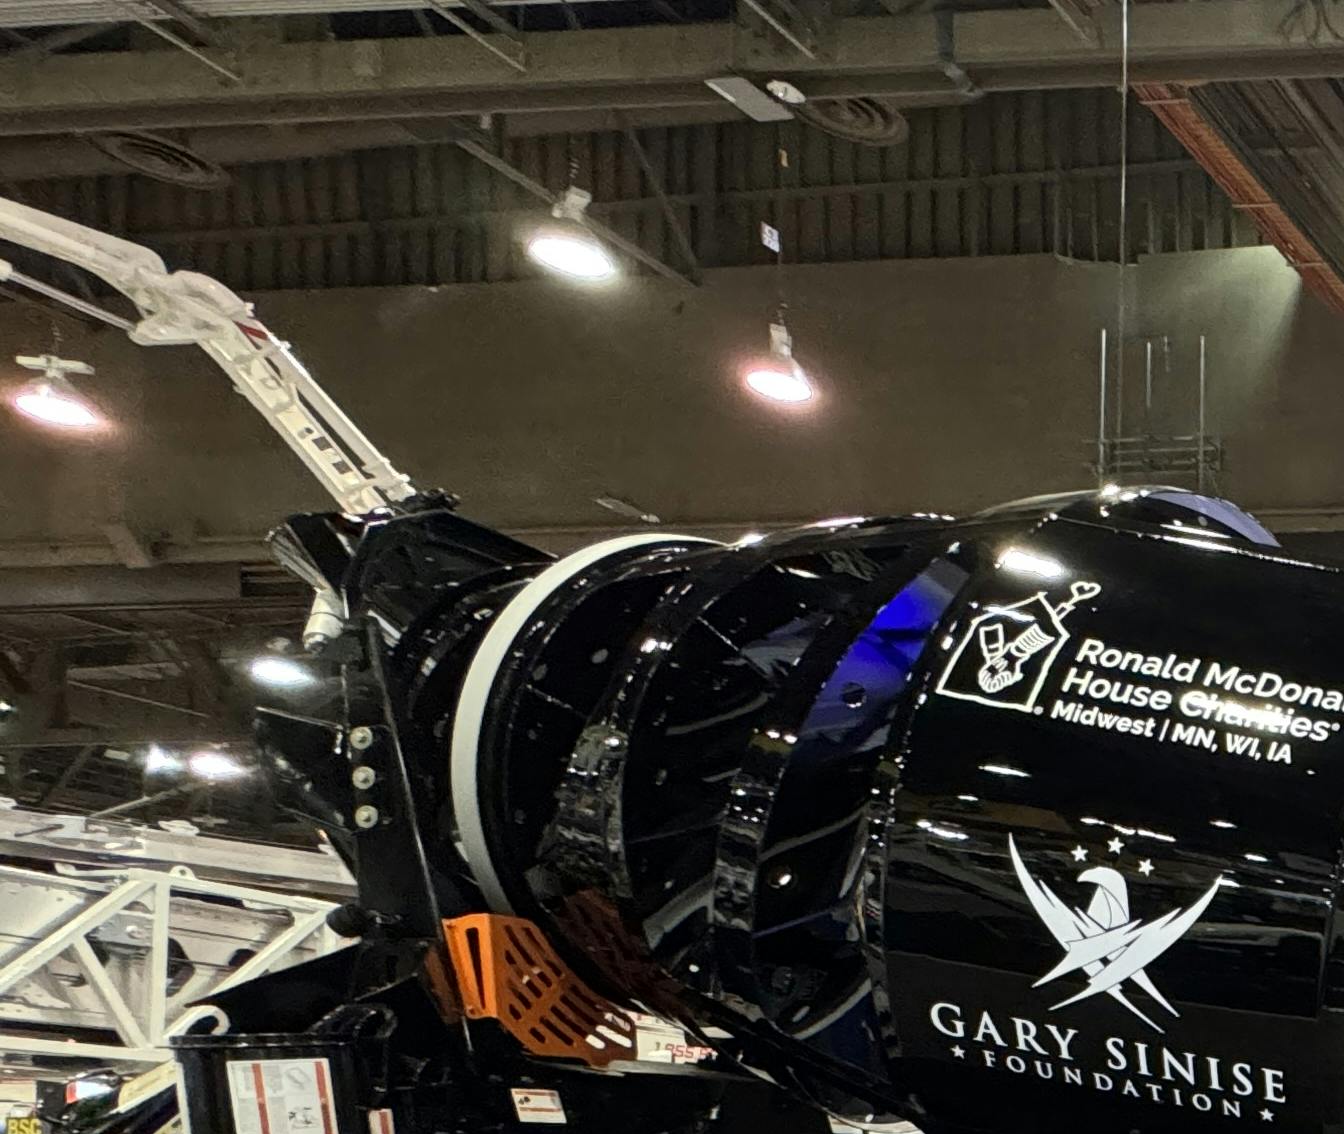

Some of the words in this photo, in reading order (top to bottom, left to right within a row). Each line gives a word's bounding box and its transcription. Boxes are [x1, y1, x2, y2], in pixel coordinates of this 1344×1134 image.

[1062, 668, 1172, 712] House
[1074, 639, 1201, 683] Ronald
[1051, 701, 1156, 738] Midwest
[1171, 723, 1218, 752] MN,
[1225, 732, 1262, 760] WI,
[1266, 742, 1293, 765] IA
[930, 1002, 1079, 1061] GARY
[1106, 1037, 1286, 1104] SINISE
[982, 1049, 1241, 1118] FOUNDATION
